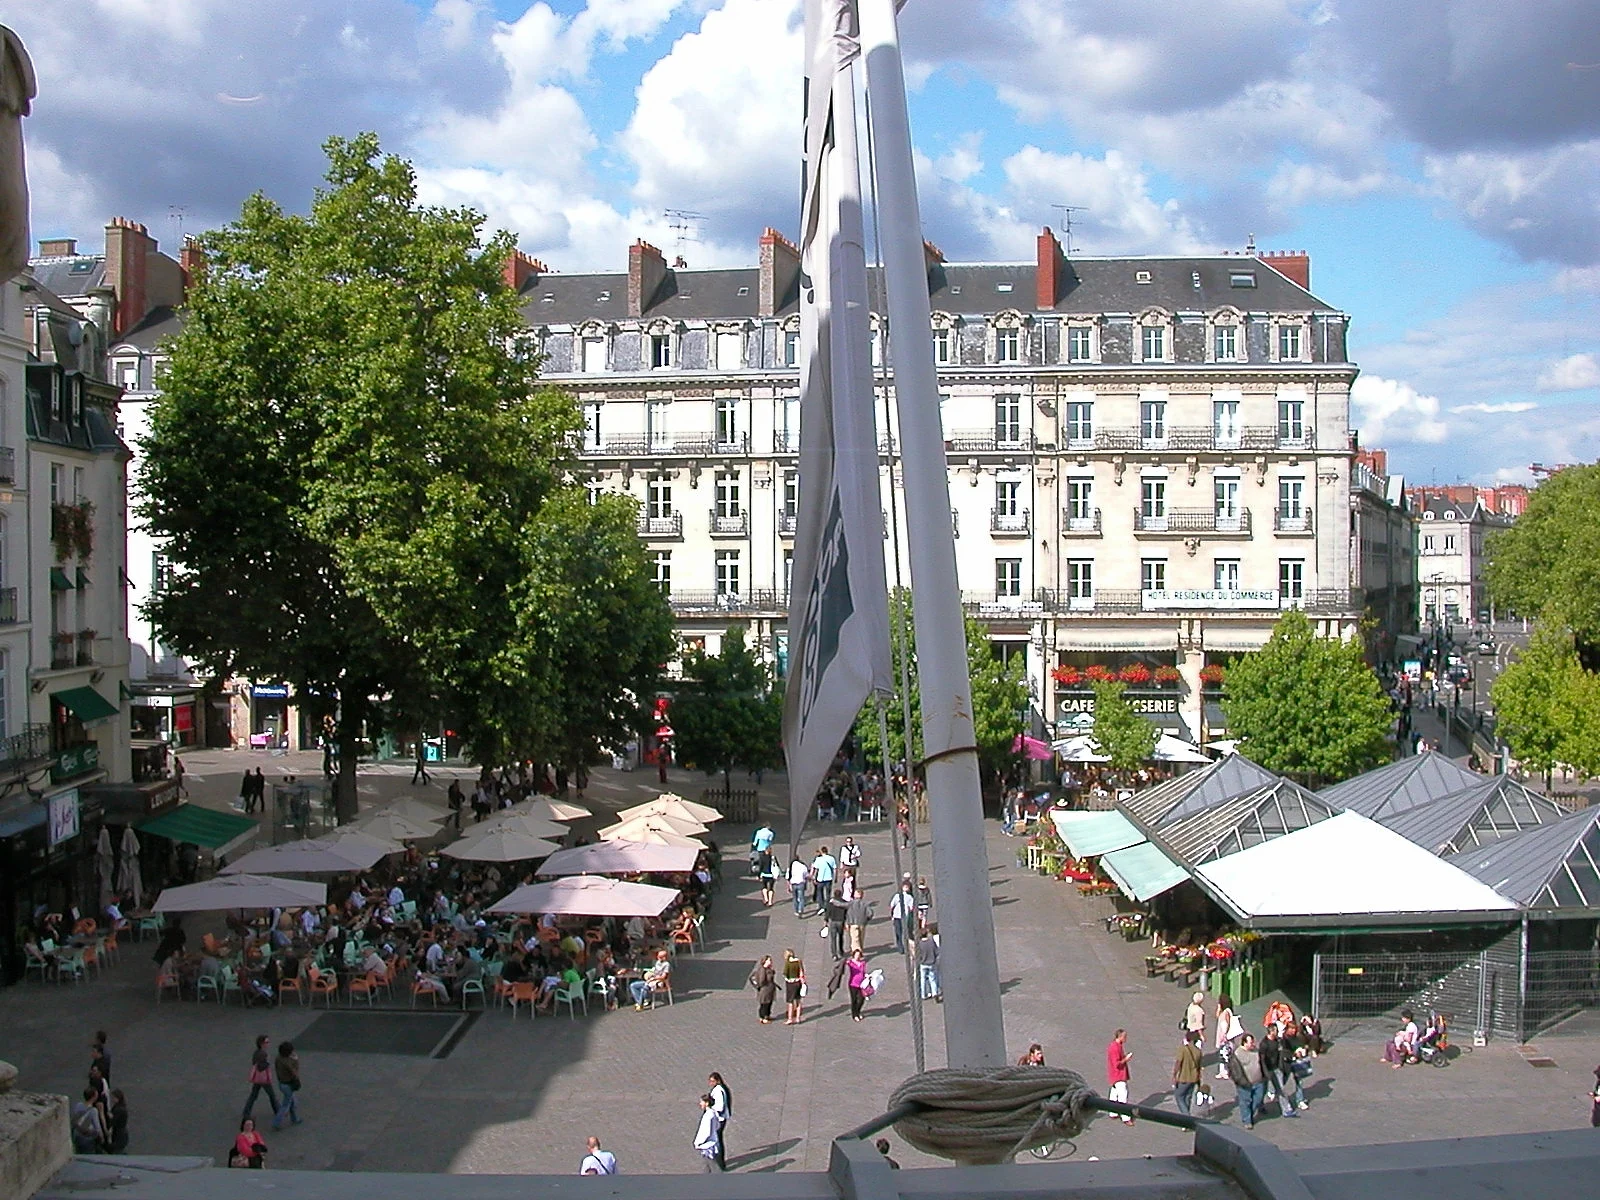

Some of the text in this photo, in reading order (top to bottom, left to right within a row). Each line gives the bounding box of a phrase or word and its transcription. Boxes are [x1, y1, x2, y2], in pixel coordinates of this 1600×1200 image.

[1147, 591, 1273, 600] HOTEL RESIDENCE DU COMMERCE
[1060, 699, 1095, 713] CAFE
